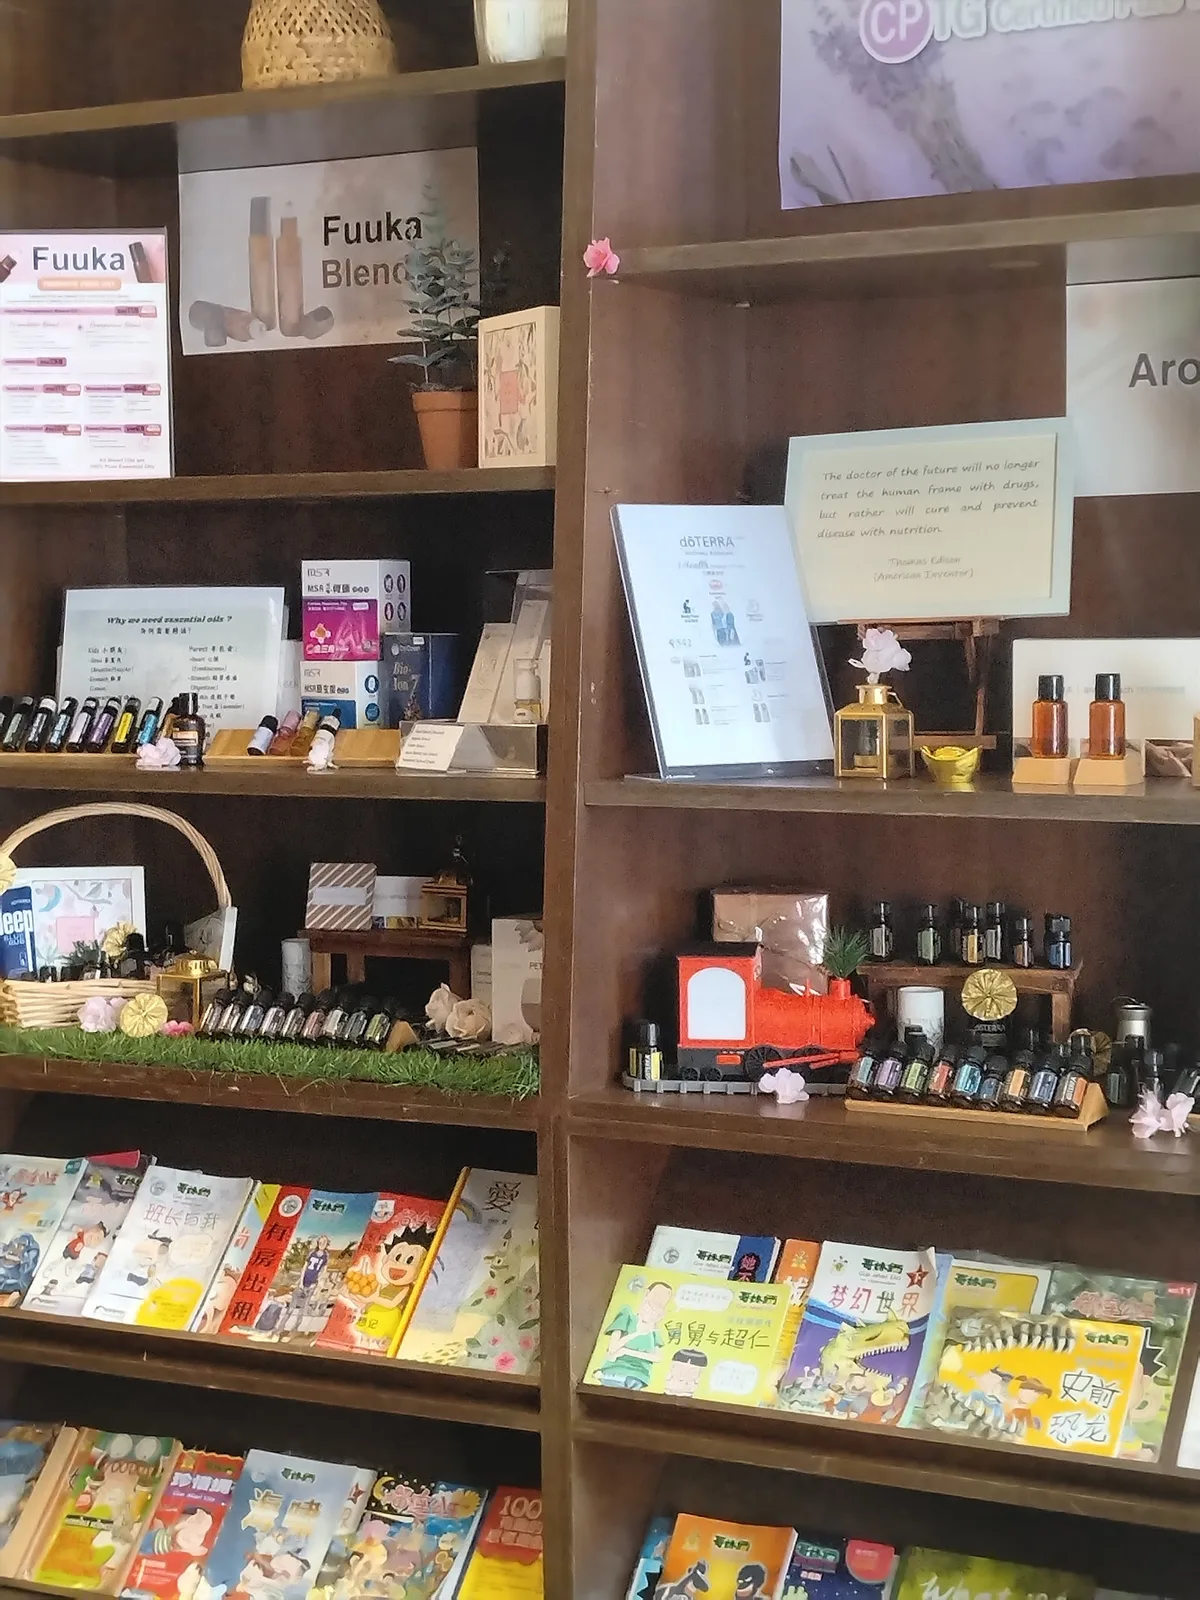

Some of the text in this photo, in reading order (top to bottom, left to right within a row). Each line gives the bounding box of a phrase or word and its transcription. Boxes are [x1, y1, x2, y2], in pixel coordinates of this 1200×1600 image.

[323, 211, 422, 246] Fuuka
[32, 247, 125, 271] Fuuka
[823, 459, 1040, 481] The doctor of the future will no longer
[820, 491, 848, 501] treat
[857, 488, 874, 499] the
[881, 486, 921, 498] human
[928, 484, 962, 495] frame
[970, 481, 996, 492] with
[819, 498, 1039, 520] but rather will cure and prevent
[817, 527, 855, 539] disease
[861, 526, 885, 537] with
[141, 616, 163, 624] need
[829, 1284, 920, 1318] 梦幻世界
[664, 1320, 771, 1350] 舅舅与超仁
[1060, 1370, 1121, 1409] 史前
[1049, 1411, 1108, 1444] 恐龙
[501, 1495, 543, 1520] 100
